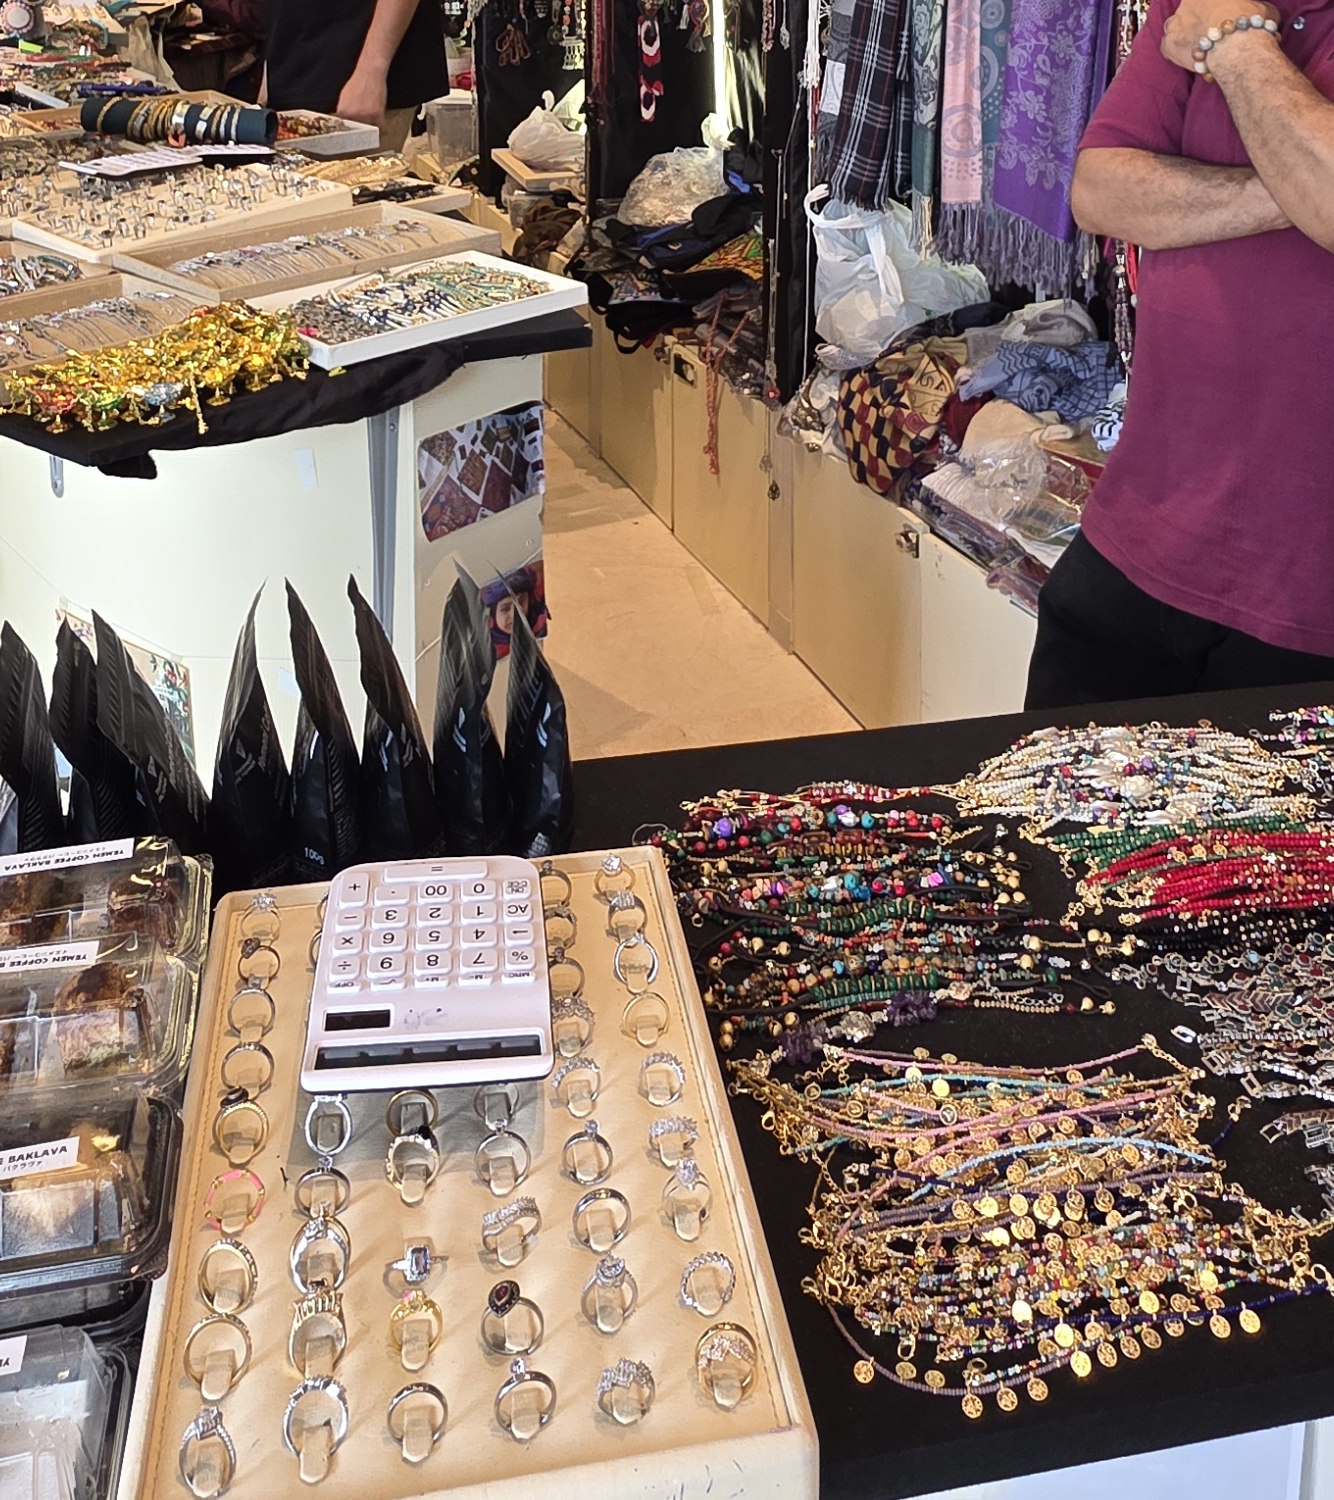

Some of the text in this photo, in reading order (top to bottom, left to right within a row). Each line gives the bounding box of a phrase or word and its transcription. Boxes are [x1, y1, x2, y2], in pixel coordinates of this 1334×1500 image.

[4, 849, 125, 872] YEMEN COFFEE BAKLAVA
[303, 846, 325, 865] 100g
[425, 885, 447, 896] 00
[473, 883, 485, 893] 0
[385, 909, 398, 921] 3
[429, 907, 442, 918] 2
[476, 905, 485, 916] 1
[507, 904, 529, 914] AC
[382, 932, 395, 944] 6
[428, 930, 441, 942] 5
[473, 928, 486, 940] 4
[9, 958, 49, 968] COFFEE
[51, 953, 88, 963] YEMEN
[379, 957, 393, 970] 9
[426, 954, 440, 967] 8
[472, 952, 486, 965] 7
[7, 1145, 68, 1164] BAKLAVA
